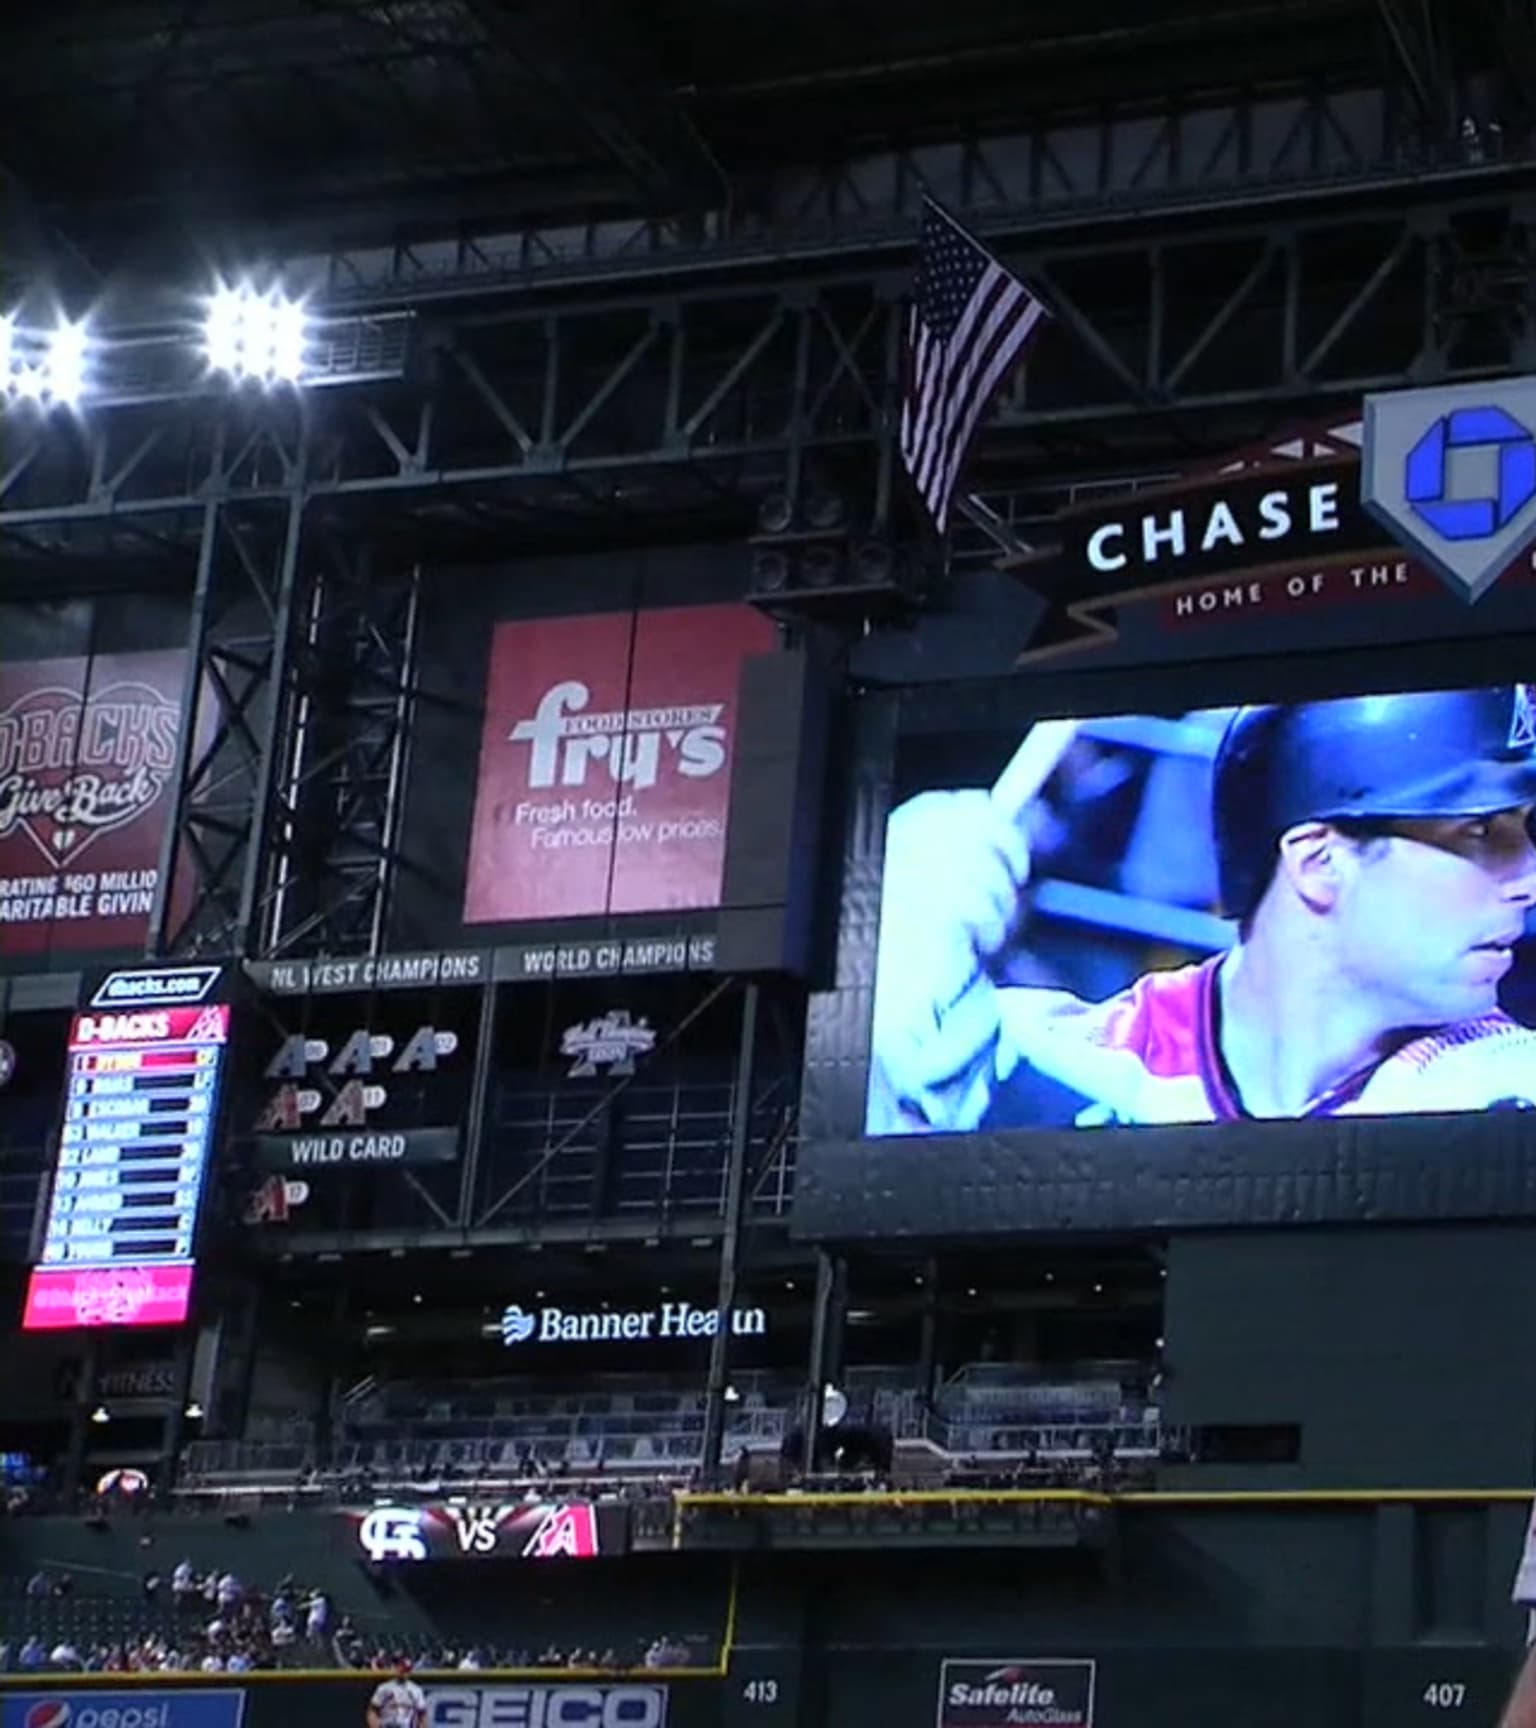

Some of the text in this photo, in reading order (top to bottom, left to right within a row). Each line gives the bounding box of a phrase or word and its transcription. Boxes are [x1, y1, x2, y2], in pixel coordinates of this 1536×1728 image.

[1087, 482, 1340, 572] CHASE
[1176, 582, 1262, 615] HOME
[1287, 574, 1324, 596] OF
[1350, 563, 1408, 587] THE
[515, 799, 575, 826] Fresh
[531, 825, 613, 849] Famous
[98, 892, 154, 914] GIVIN
[523, 941, 715, 974] WORLD CHAMPIONS
[272, 955, 481, 989] NL WEST CHAMPIONS
[108, 976, 200, 998] dbacks.com
[76, 1012, 170, 1042] D-BACKS
[291, 1135, 406, 1163] WILD CARD
[539, 1302, 766, 1341] Banner Heath
[457, 1517, 497, 1552] VS
[743, 1684, 778, 1703] 413
[949, 1681, 1056, 1707] Safelite
[1423, 1682, 1466, 1707] 407
[75, 1701, 170, 1728] pepsi
[425, 1688, 662, 1728] GEICO
[1005, 1706, 1083, 1725] AutoGlass
